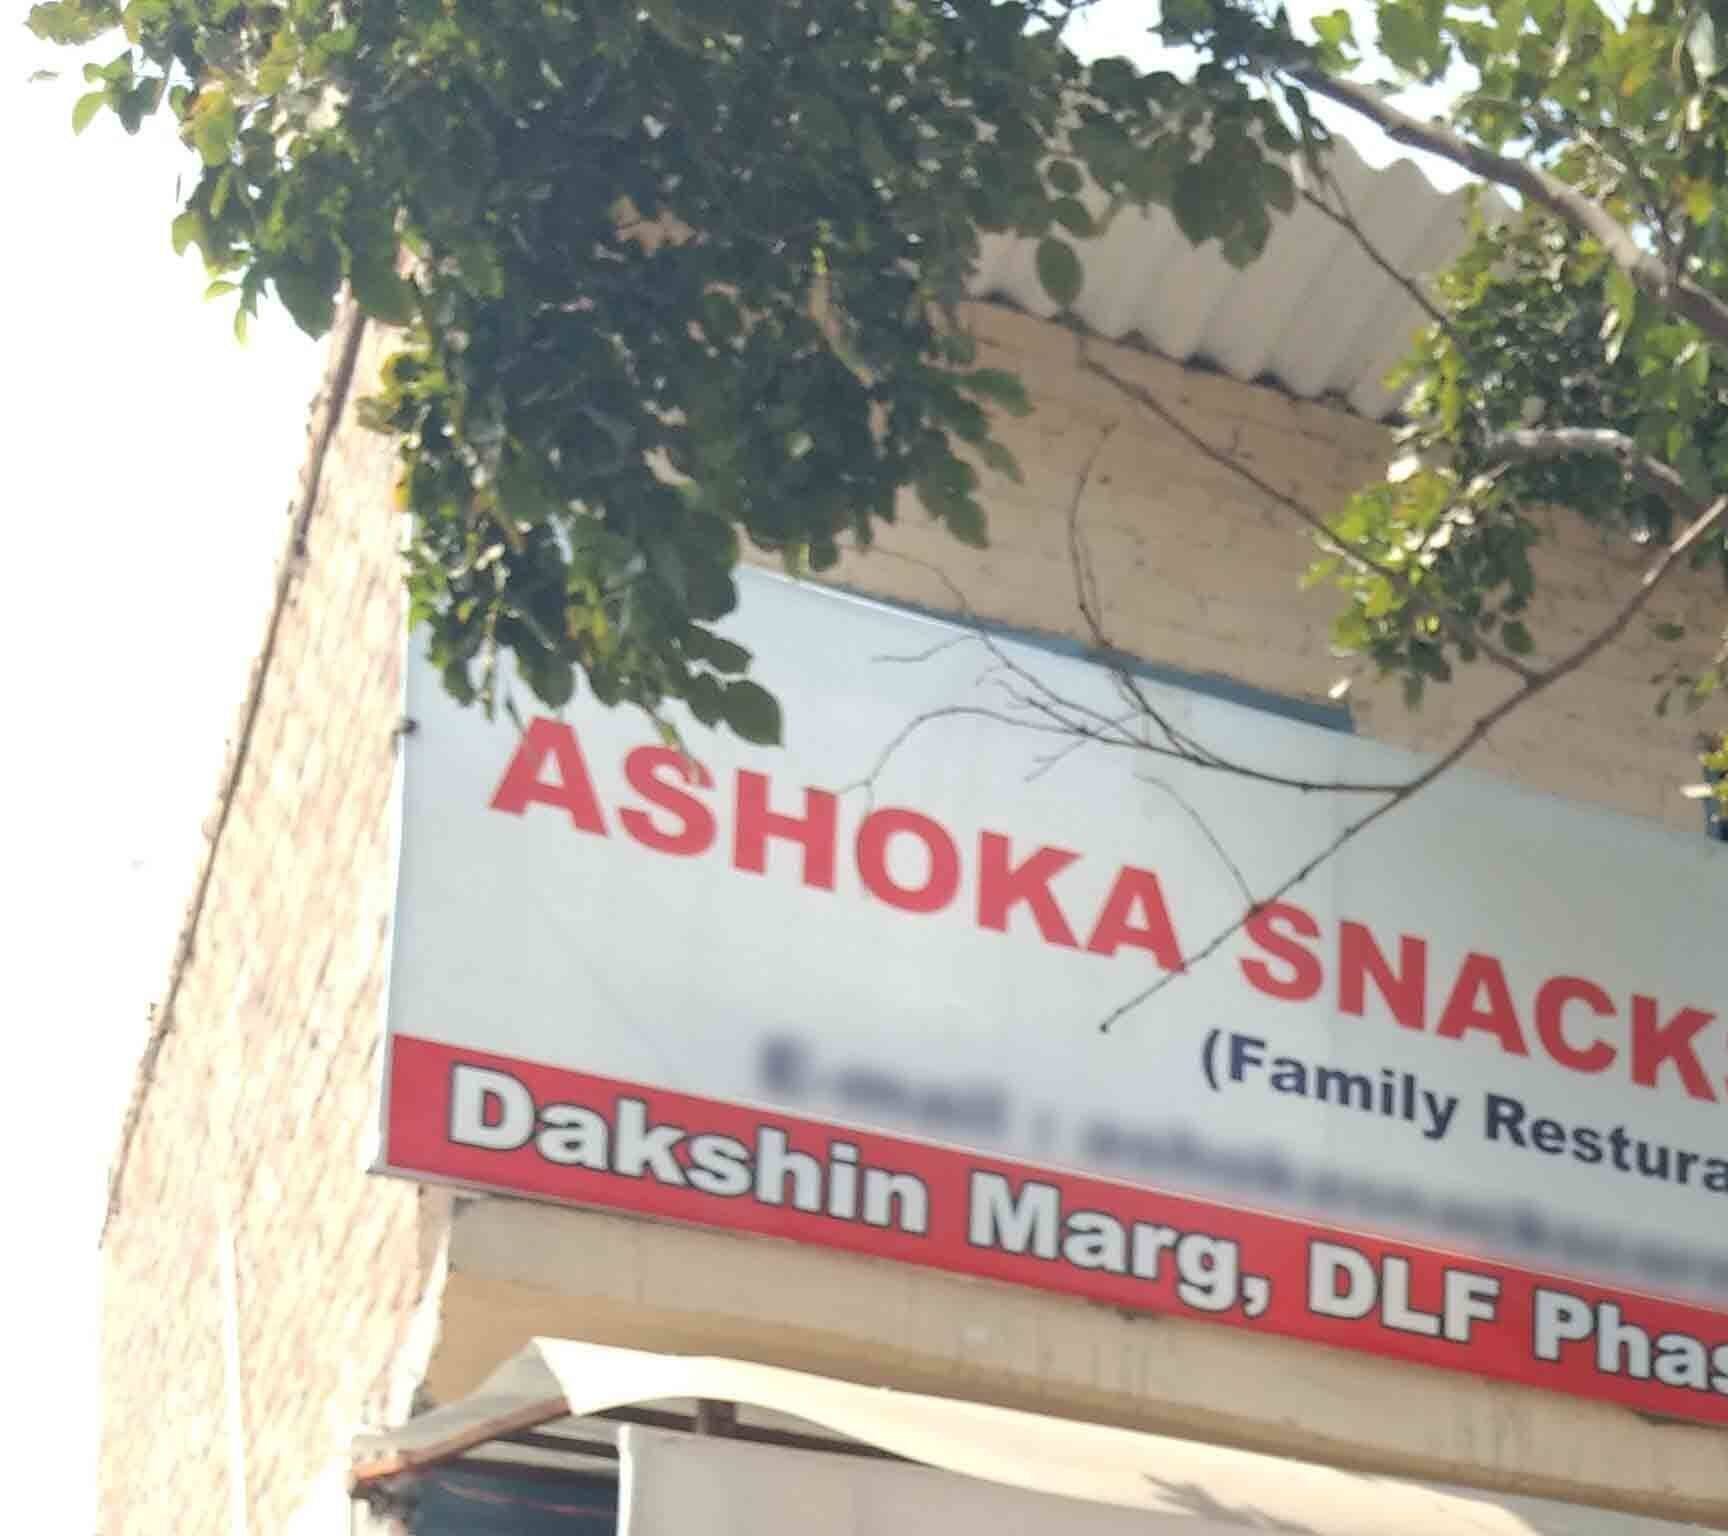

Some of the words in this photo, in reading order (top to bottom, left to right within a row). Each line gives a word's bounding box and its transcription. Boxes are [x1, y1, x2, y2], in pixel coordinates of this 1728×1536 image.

[489, 716, 1186, 972] ASHOKA
[449, 1063, 927, 1235] Dakshin
[967, 1173, 1270, 1317] Marg,
[1306, 1242, 1503, 1344] DLF
[1202, 1027, 1458, 1141] (Family
